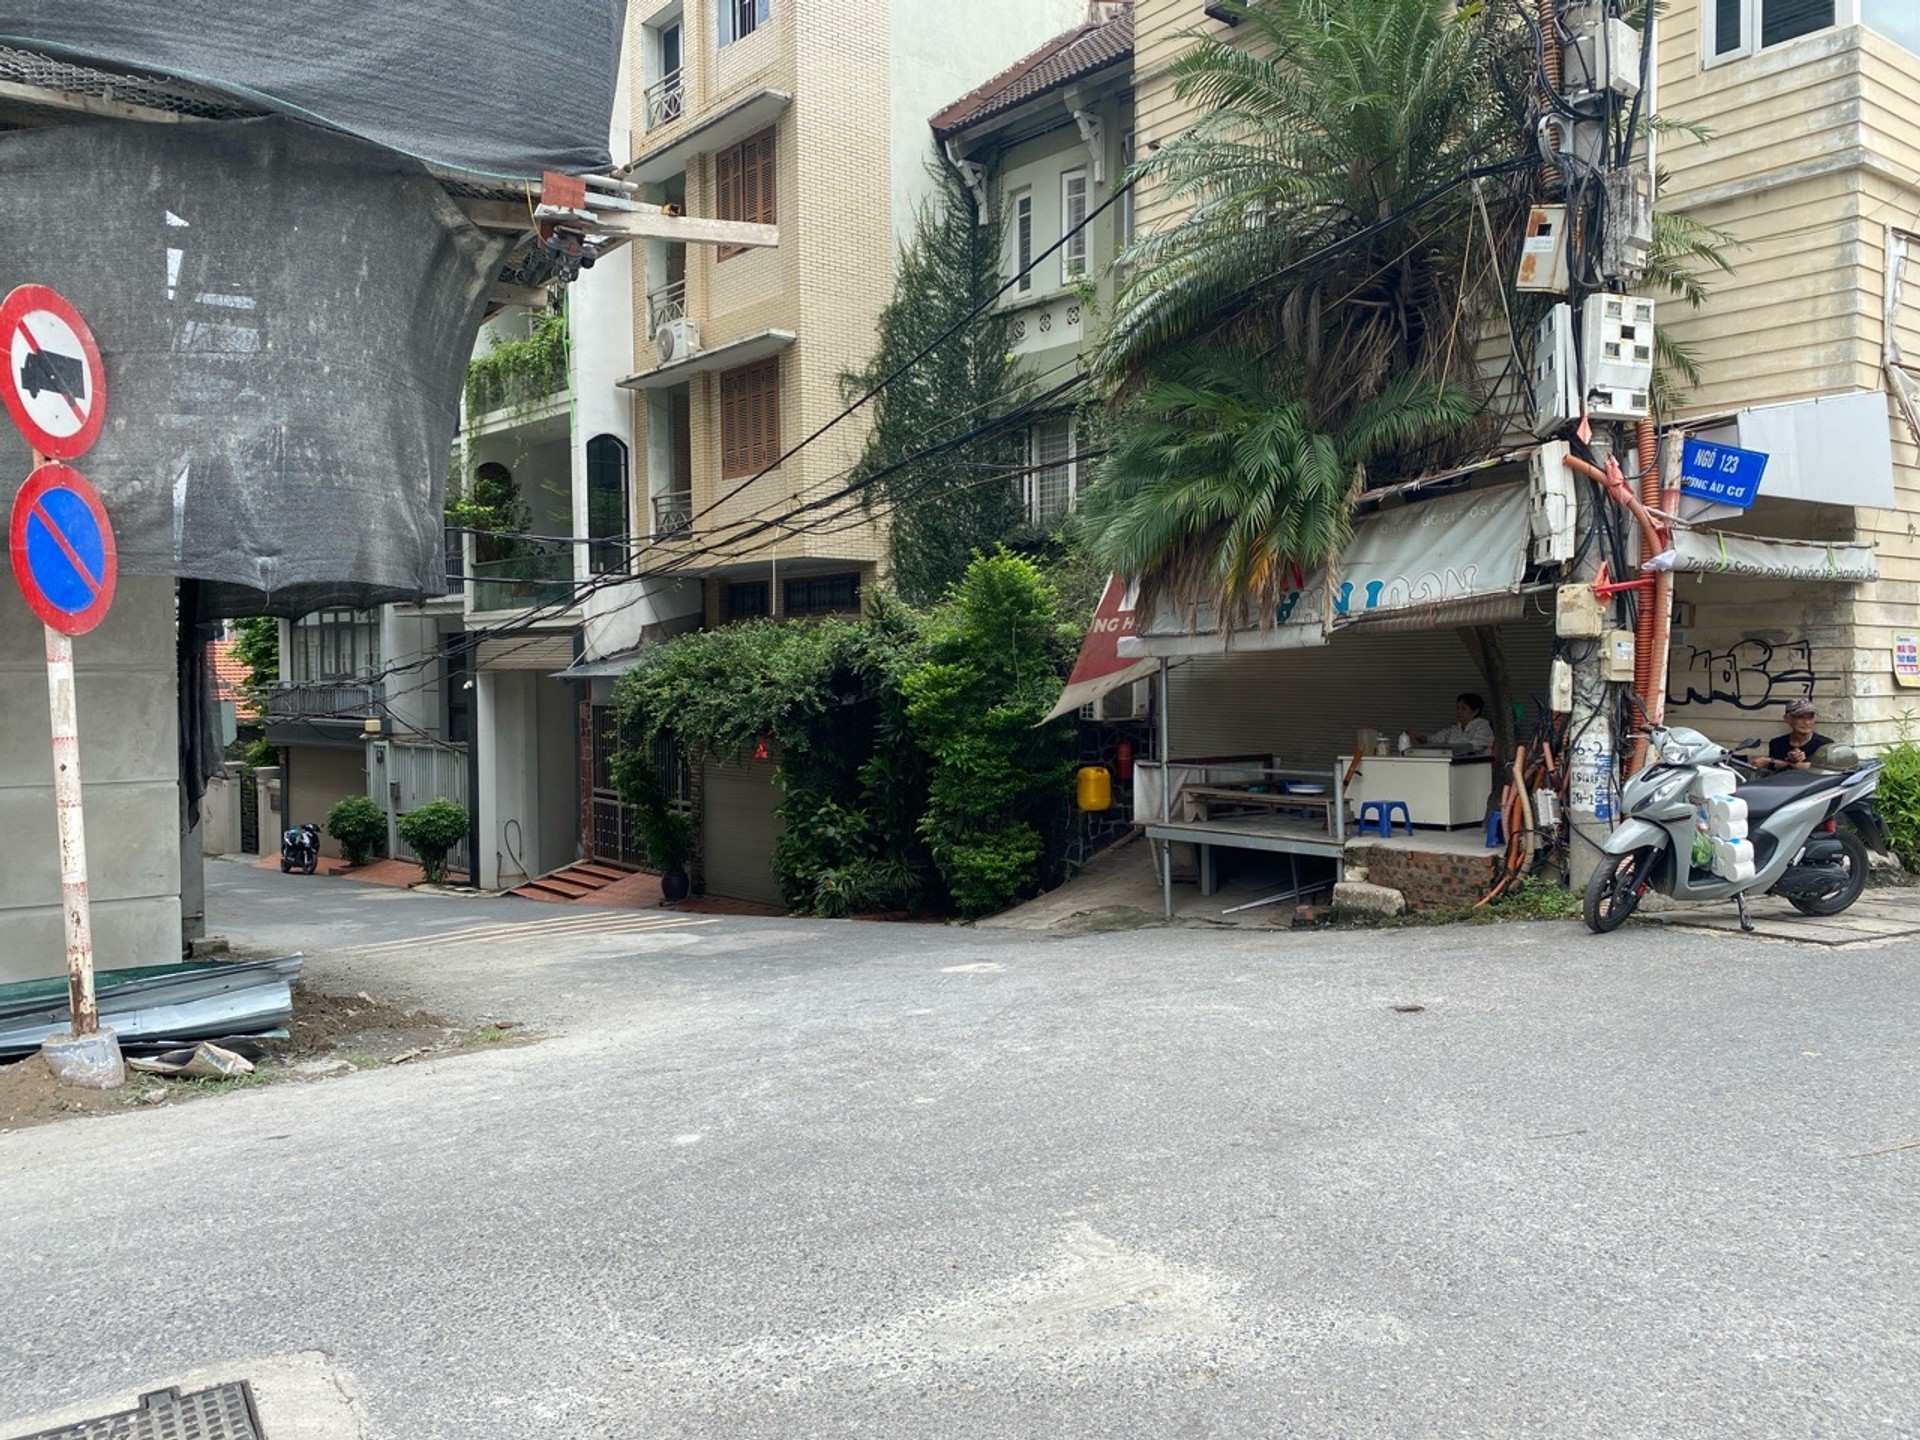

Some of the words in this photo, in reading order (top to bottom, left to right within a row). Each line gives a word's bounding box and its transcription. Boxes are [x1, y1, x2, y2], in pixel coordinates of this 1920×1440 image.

[1694, 448, 1718, 469] NGÕ
[1719, 454, 1740, 474] 123
[1726, 485, 1746, 498] CƠ
